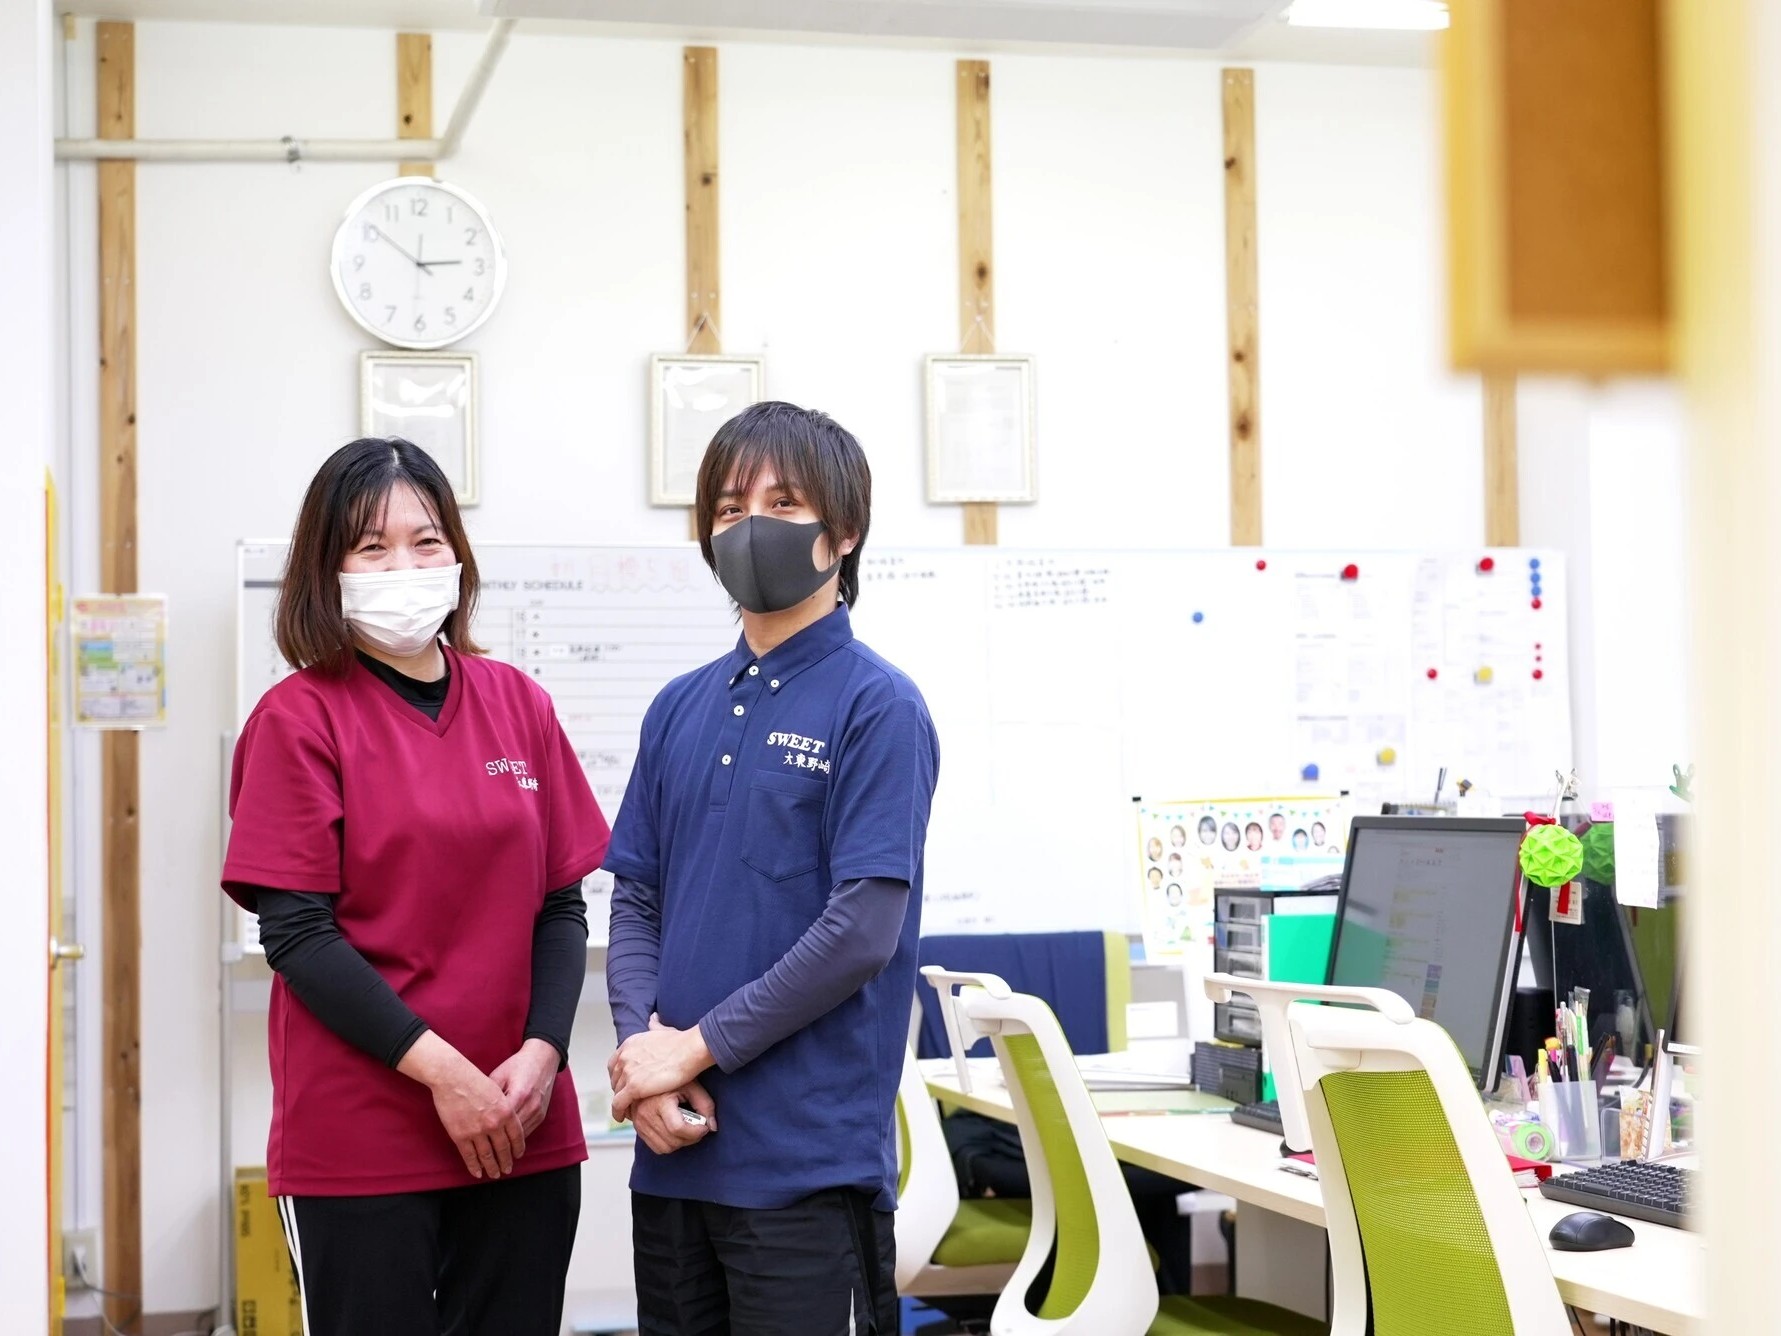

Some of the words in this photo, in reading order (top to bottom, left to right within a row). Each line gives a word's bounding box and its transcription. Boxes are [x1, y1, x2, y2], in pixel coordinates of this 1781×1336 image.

[385, 204, 399, 223] 11
[410, 198, 428, 217] 12
[363, 224, 379, 243] 10
[464, 227, 477, 246] 2
[352, 254, 366, 272] 9
[473, 257, 485, 276] 3
[359, 282, 372, 301] 8
[463, 286, 475, 302] 4
[384, 305, 397, 323] 7
[414, 314, 426, 332] 6
[444, 306, 456, 325] 5
[766, 731, 826, 754] SWEET
[485, 757, 528, 776] SWET
